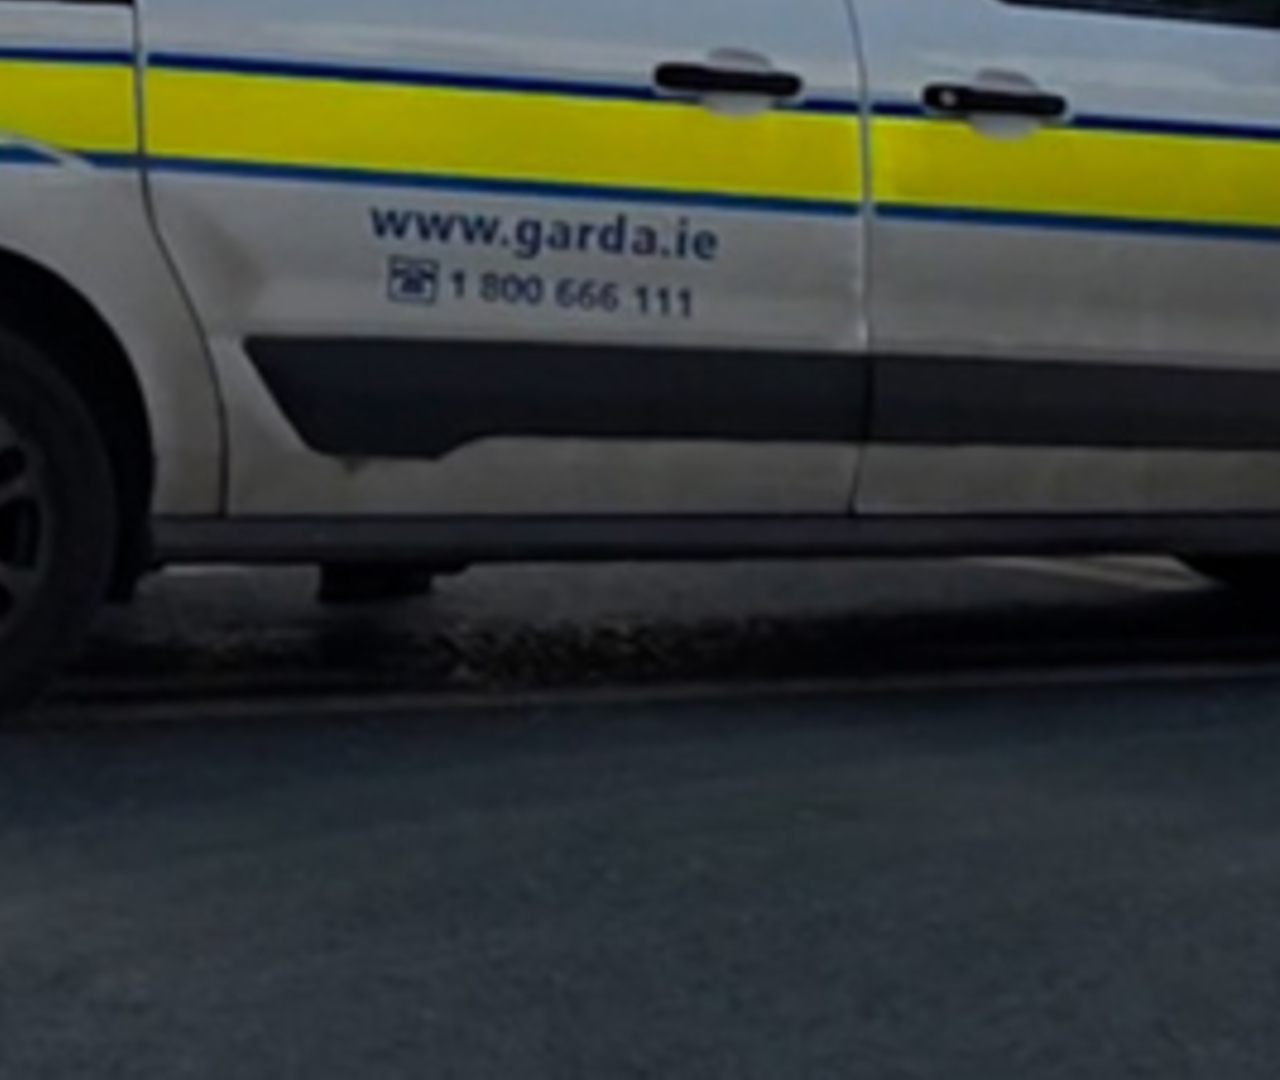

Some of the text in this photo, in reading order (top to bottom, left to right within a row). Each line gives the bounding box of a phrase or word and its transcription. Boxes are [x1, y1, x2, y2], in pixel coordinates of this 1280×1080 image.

[369, 207, 720, 260] www.garda.ie
[450, 270, 693, 318] 1 800 666 111
